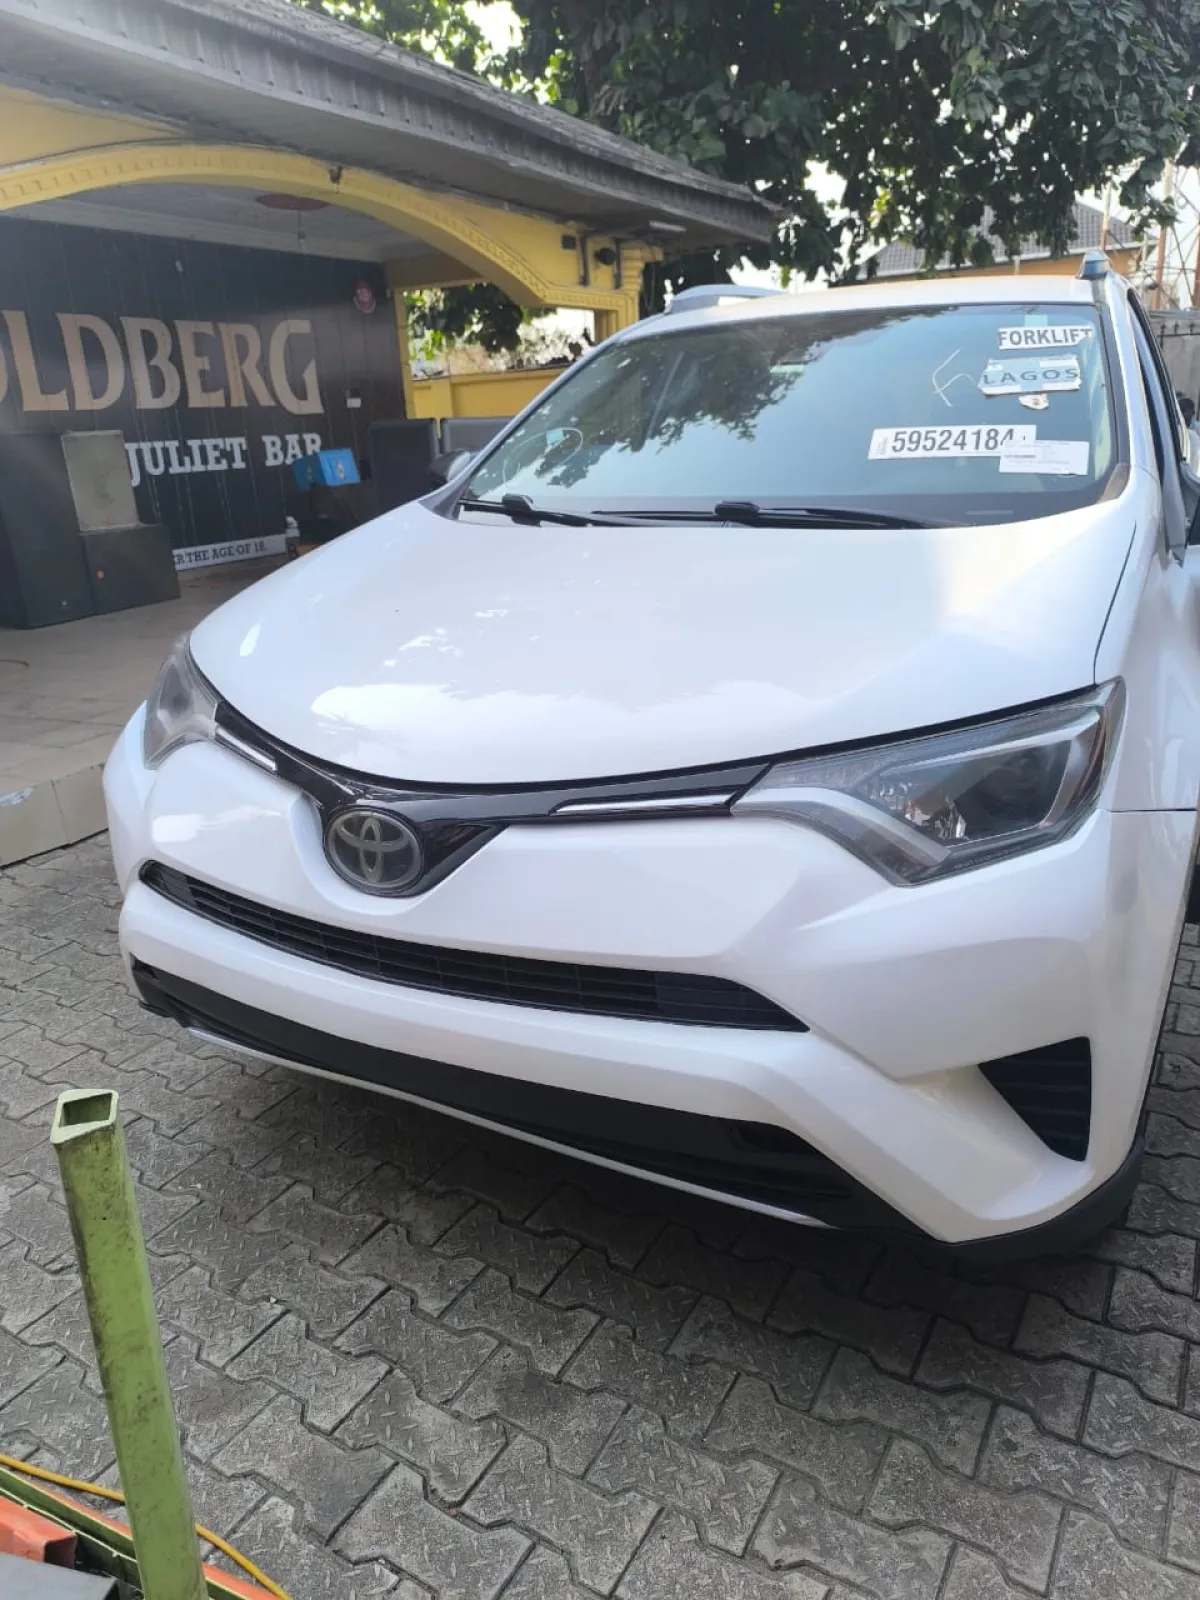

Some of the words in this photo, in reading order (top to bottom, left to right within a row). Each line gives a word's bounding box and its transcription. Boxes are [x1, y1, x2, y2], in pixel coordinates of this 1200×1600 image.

[998, 328, 1093, 346] FORKLIFT
[0, 310, 324, 415] LDBERG
[983, 368, 1078, 385] LAGOS
[124, 436, 247, 487] JULIET
[262, 432, 322, 467] BAR
[185, 549, 210, 563] THE
[212, 545, 235, 559] AGE
[236, 542, 251, 555] OF
